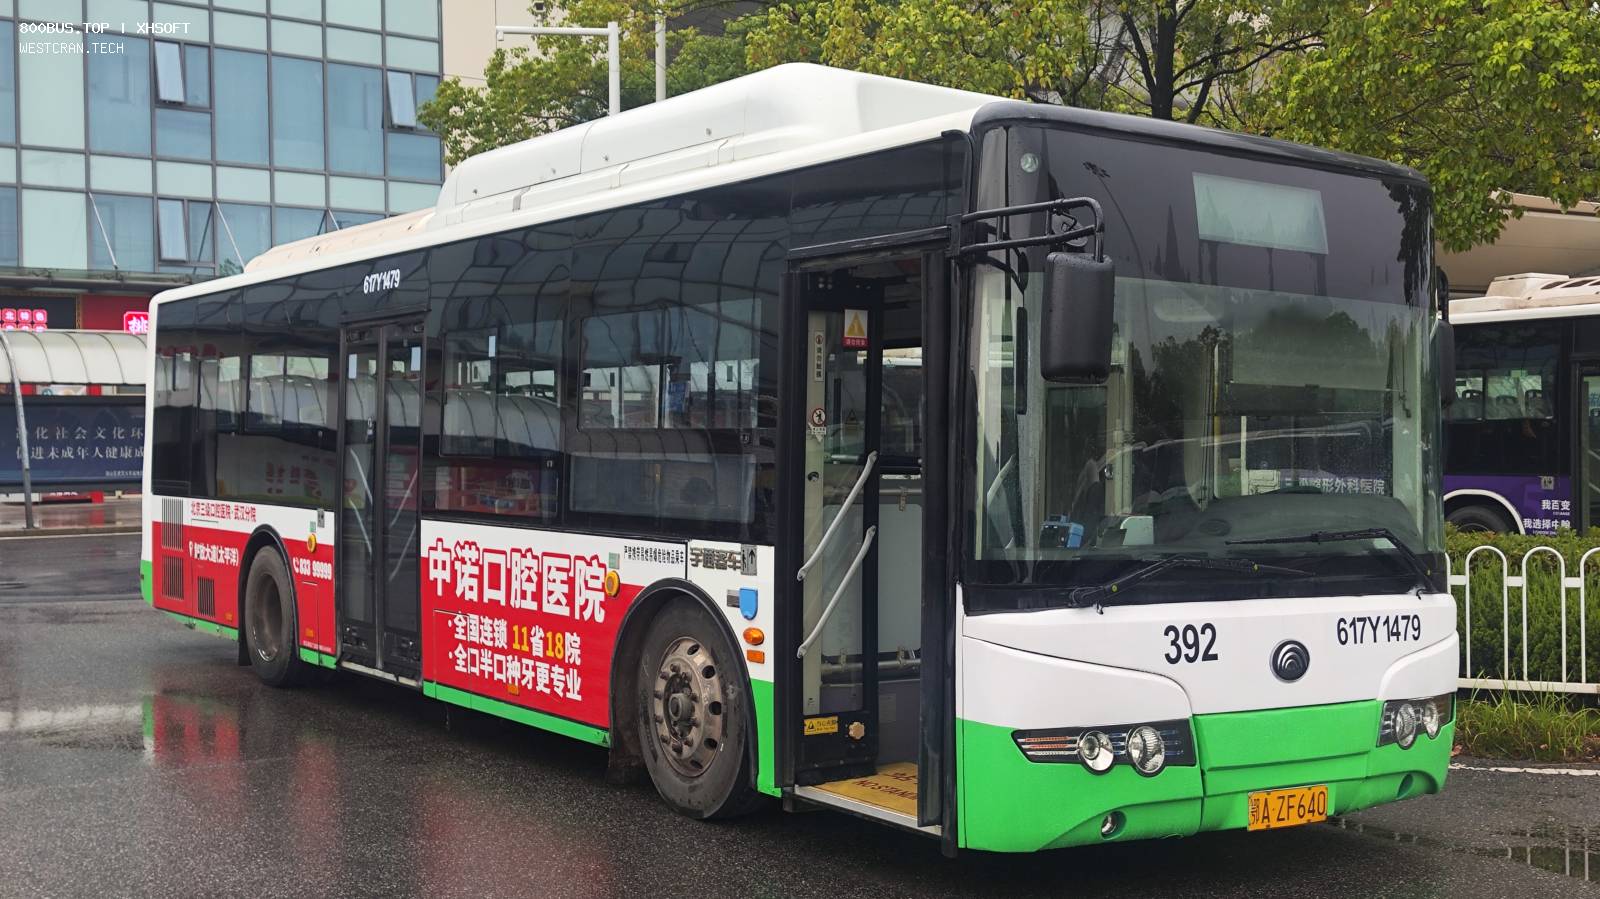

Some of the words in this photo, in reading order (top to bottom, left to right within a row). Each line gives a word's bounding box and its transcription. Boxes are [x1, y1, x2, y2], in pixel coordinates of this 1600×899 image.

[363, 268, 401, 294] 617Y1479
[1541, 500, 1571, 510] 我百变
[428, 537, 607, 624] 中诺口腔医院
[454, 611, 508, 650] 全国连锁
[1163, 622, 1219, 665] 392
[1336, 614, 1421, 646] 617Y1479
[454, 643, 582, 702] 全口半口种牙更专业
